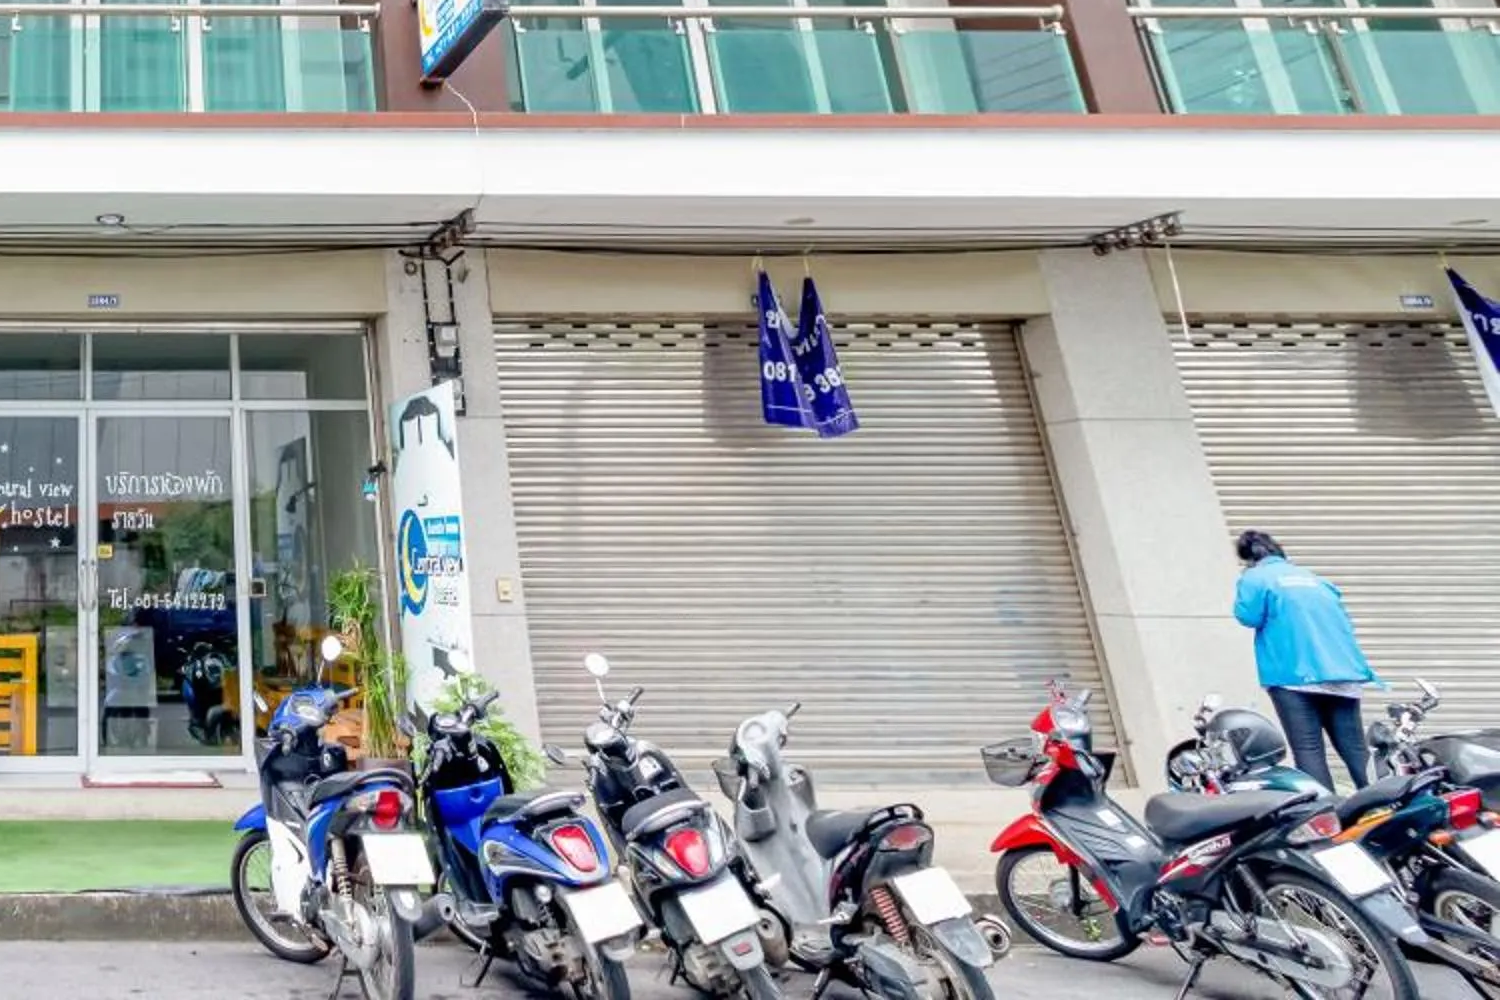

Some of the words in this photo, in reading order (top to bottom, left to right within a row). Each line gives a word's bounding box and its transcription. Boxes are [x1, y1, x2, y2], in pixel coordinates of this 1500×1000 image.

[763, 361, 797, 382] 081
[39, 483, 74, 497] view
[105, 470, 224, 496] บริการห้องพัก
[11, 500, 70, 528] hostel
[112, 508, 155, 530] รายวัน
